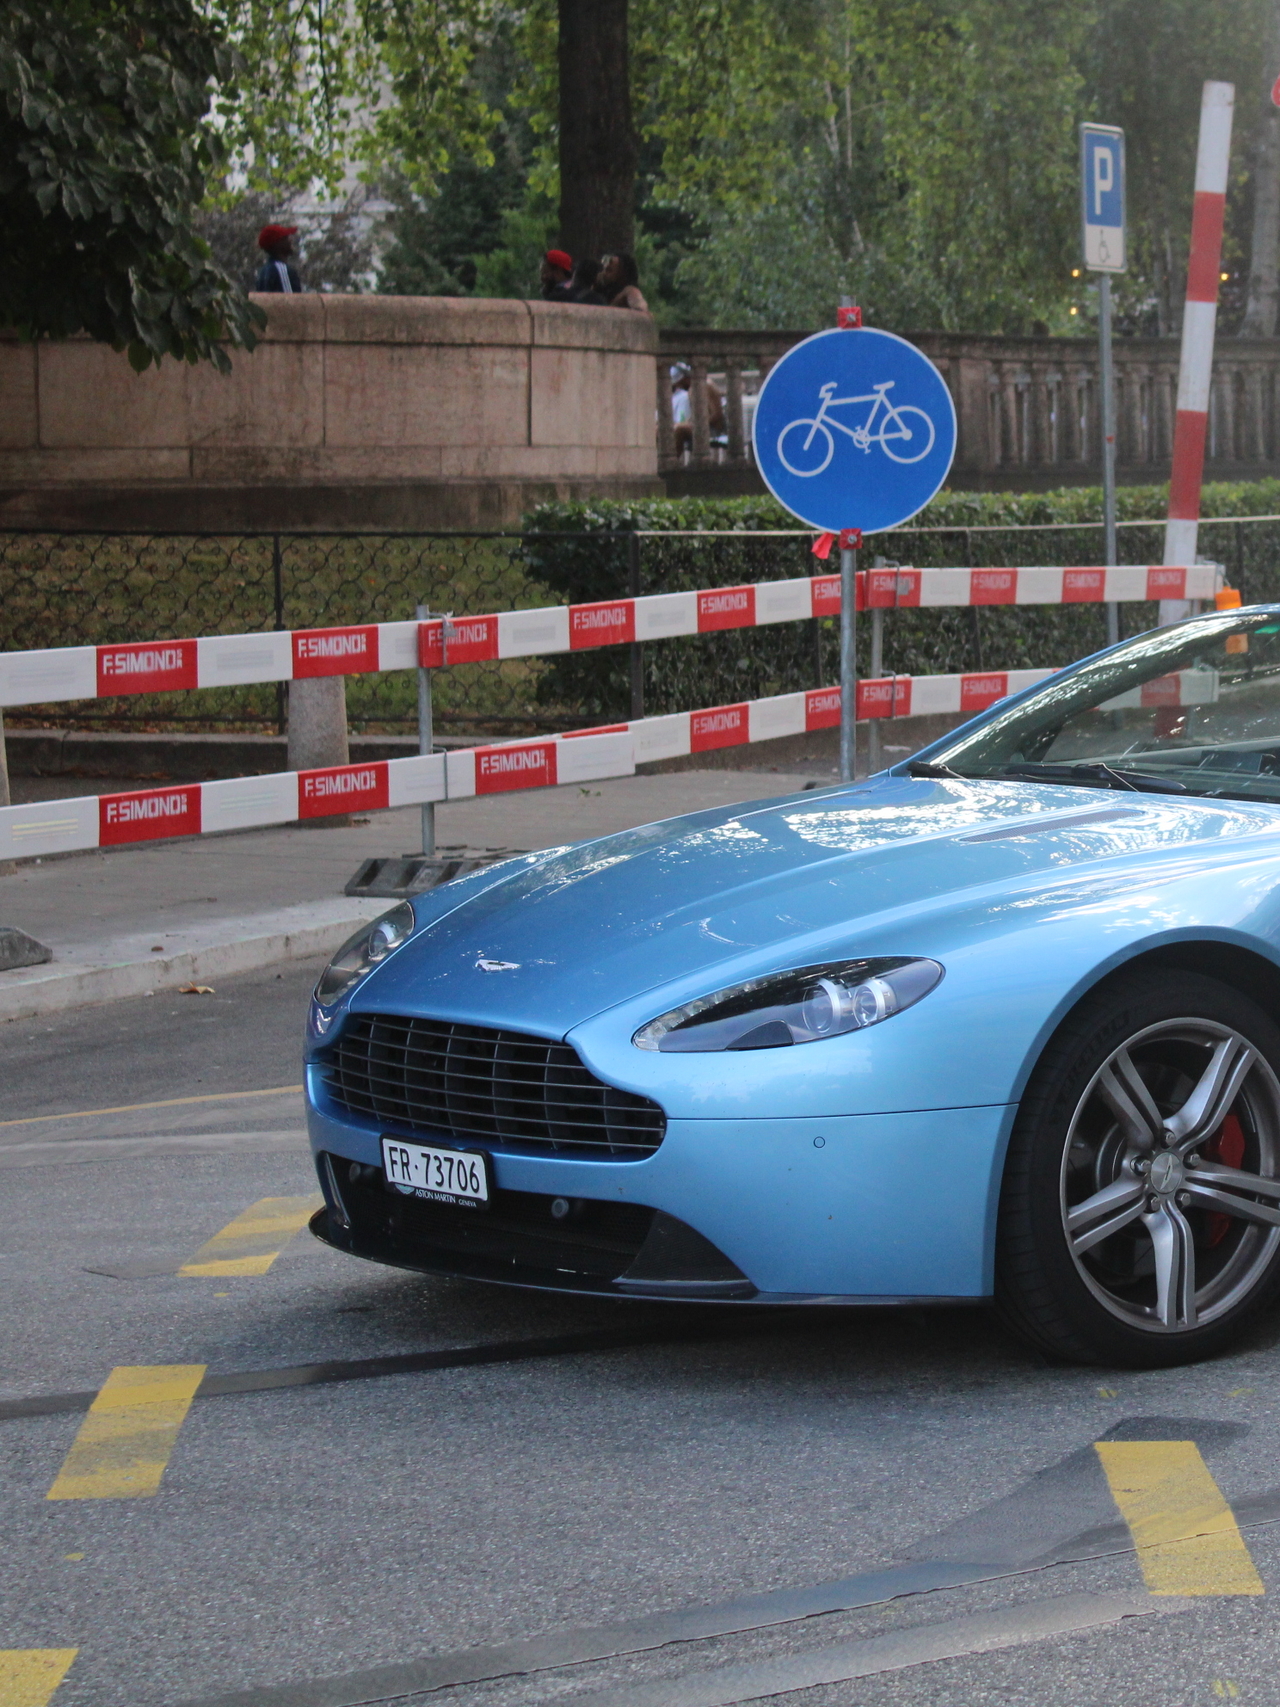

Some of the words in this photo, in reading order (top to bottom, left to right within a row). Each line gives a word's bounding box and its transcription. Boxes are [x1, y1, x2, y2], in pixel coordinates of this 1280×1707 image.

[1094, 146, 1114, 216] P
[415, 1188, 434, 1200] ASTON
[434, 1192, 456, 1204] MARTIN
